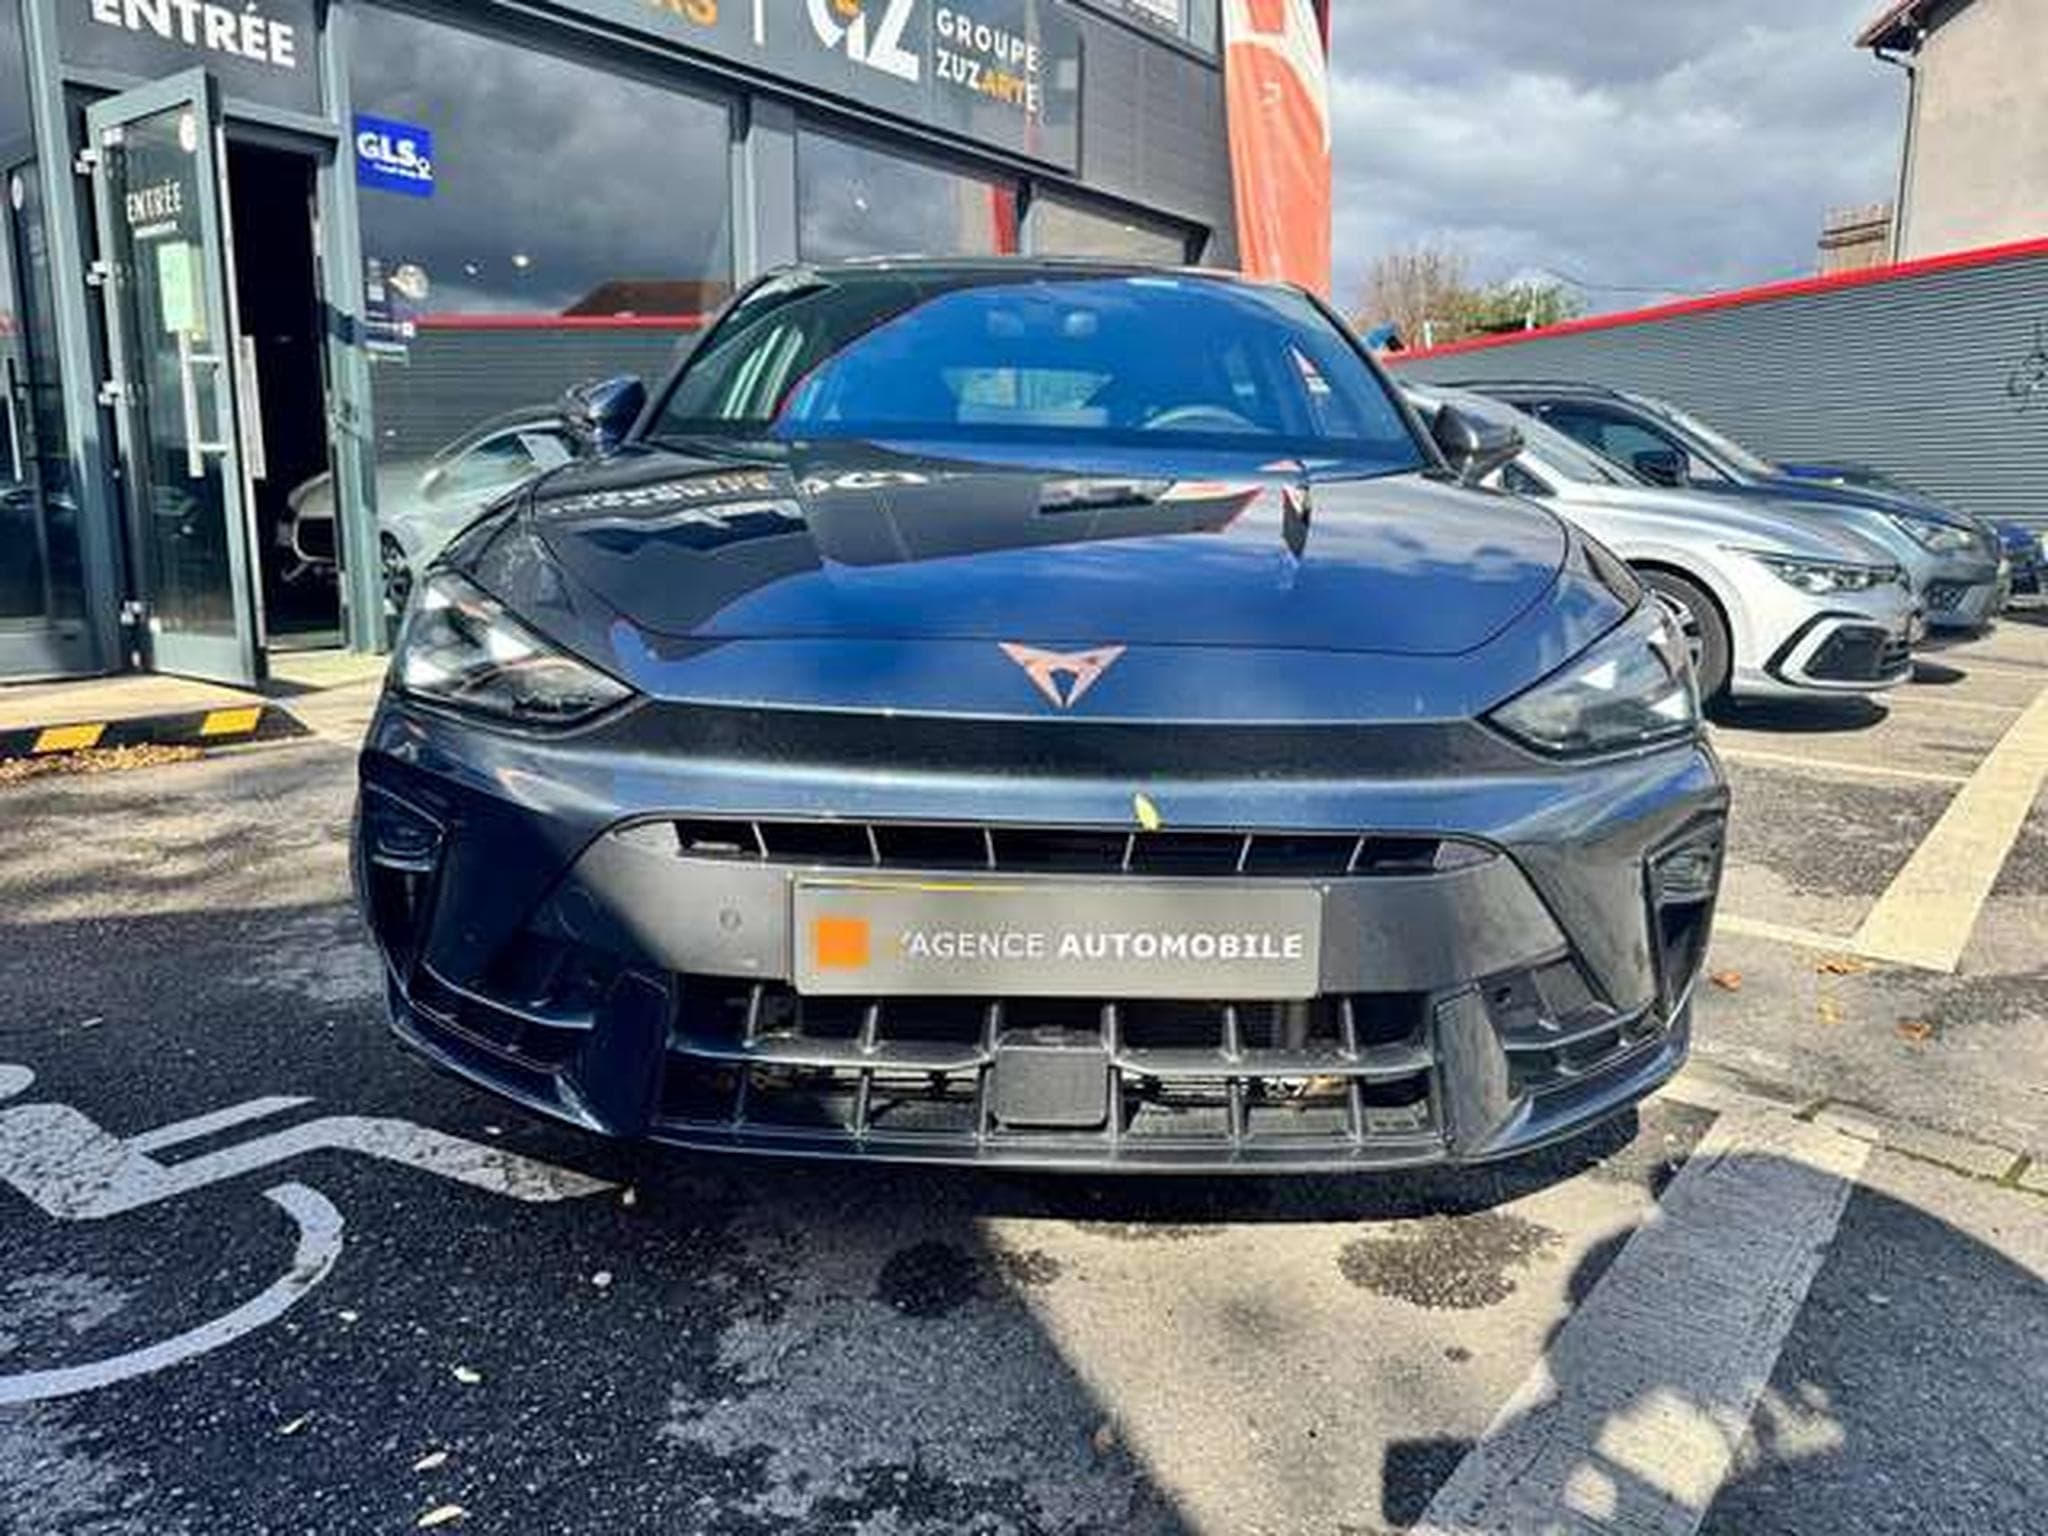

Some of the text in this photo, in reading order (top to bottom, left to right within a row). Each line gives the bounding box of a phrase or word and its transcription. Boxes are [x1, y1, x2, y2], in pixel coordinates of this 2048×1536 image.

[92, 0, 296, 68] ENTRÉE
[936, 7, 1040, 73] GROUPE
[357, 131, 417, 167] GLS
[1058, 932, 1303, 959] AUTOMOBILE
